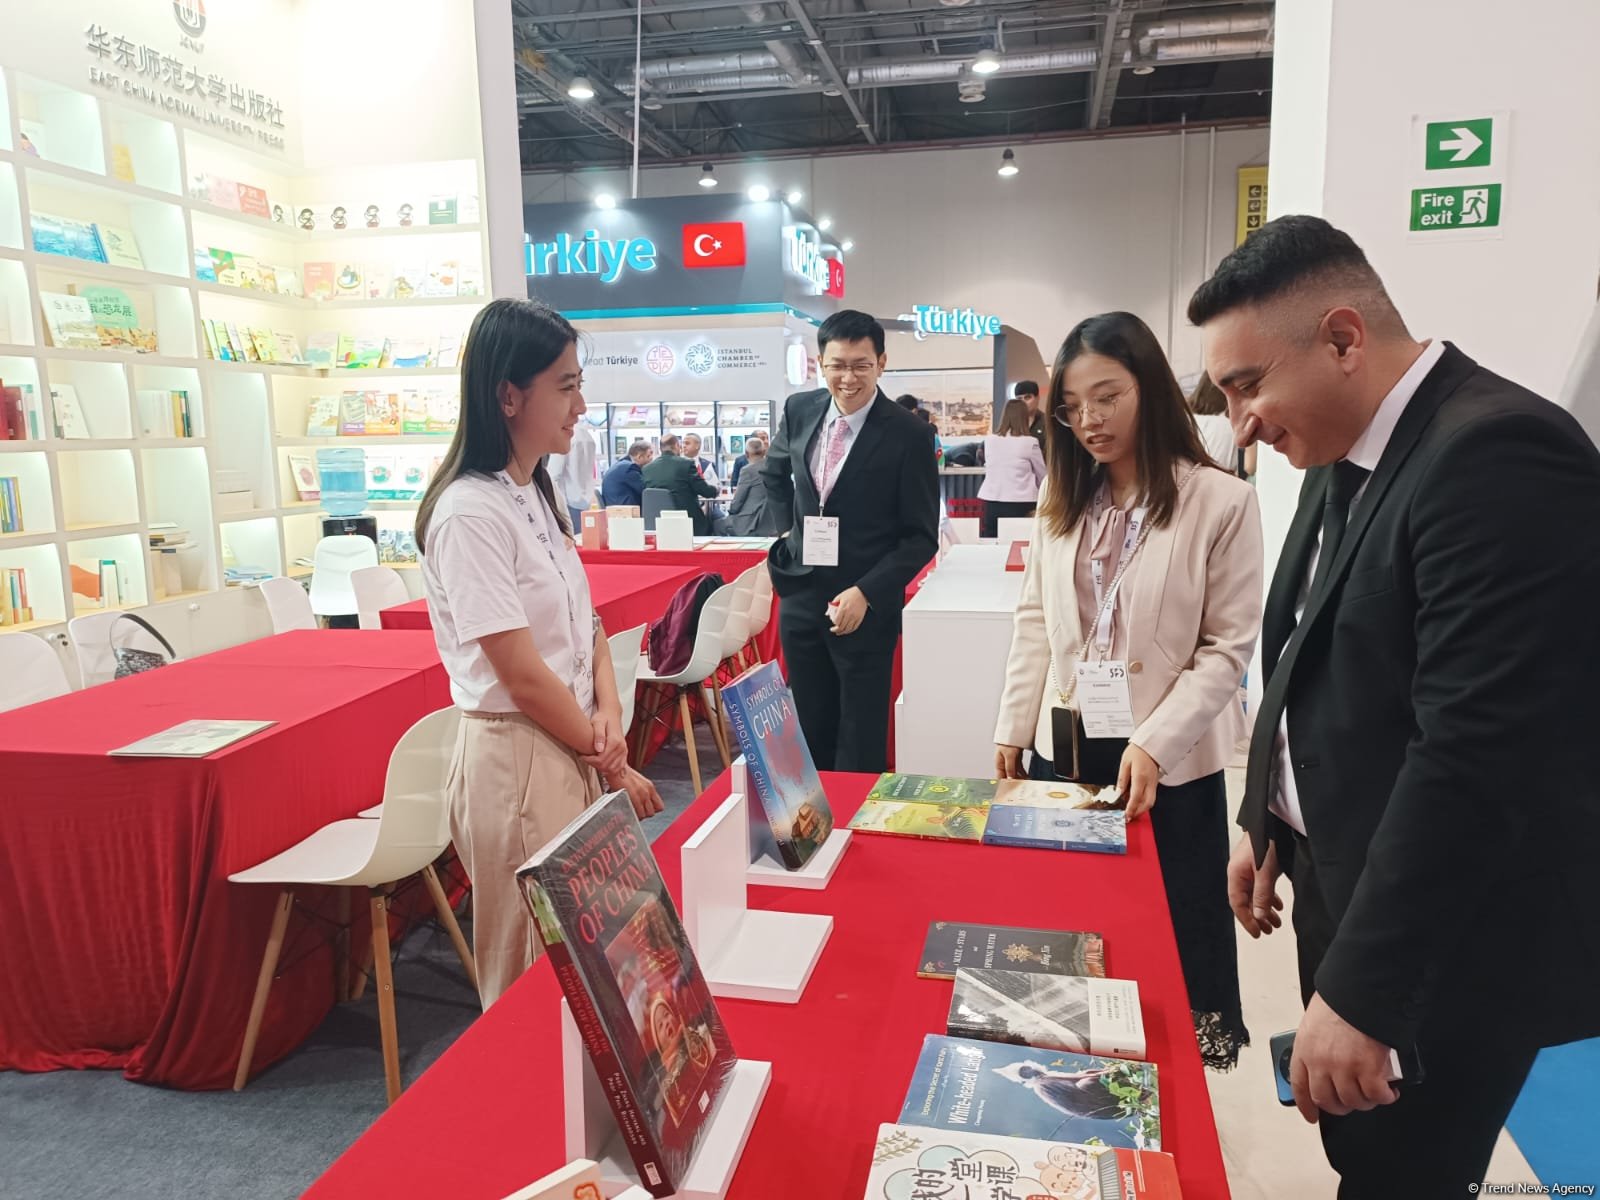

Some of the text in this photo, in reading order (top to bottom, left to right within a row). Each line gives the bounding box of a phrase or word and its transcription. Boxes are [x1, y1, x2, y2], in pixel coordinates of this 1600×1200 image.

[85, 23, 285, 128] 华东师范大学出版社
[1420, 192, 1455, 208] Fire
[1420, 209, 1453, 226] exit
[913, 304, 1001, 340] Türkiye
[606, 356, 639, 367] Türkiye
[746, 682, 776, 709] SYMBOLS
[752, 698, 792, 740] CHINA
[729, 703, 773, 803] SYMBOLS OF CHINA
[567, 824, 638, 908] PEOPLES
[579, 899, 606, 944] OF
[604, 852, 655, 916] CHINA
[947, 1071, 979, 1124] White-headed
